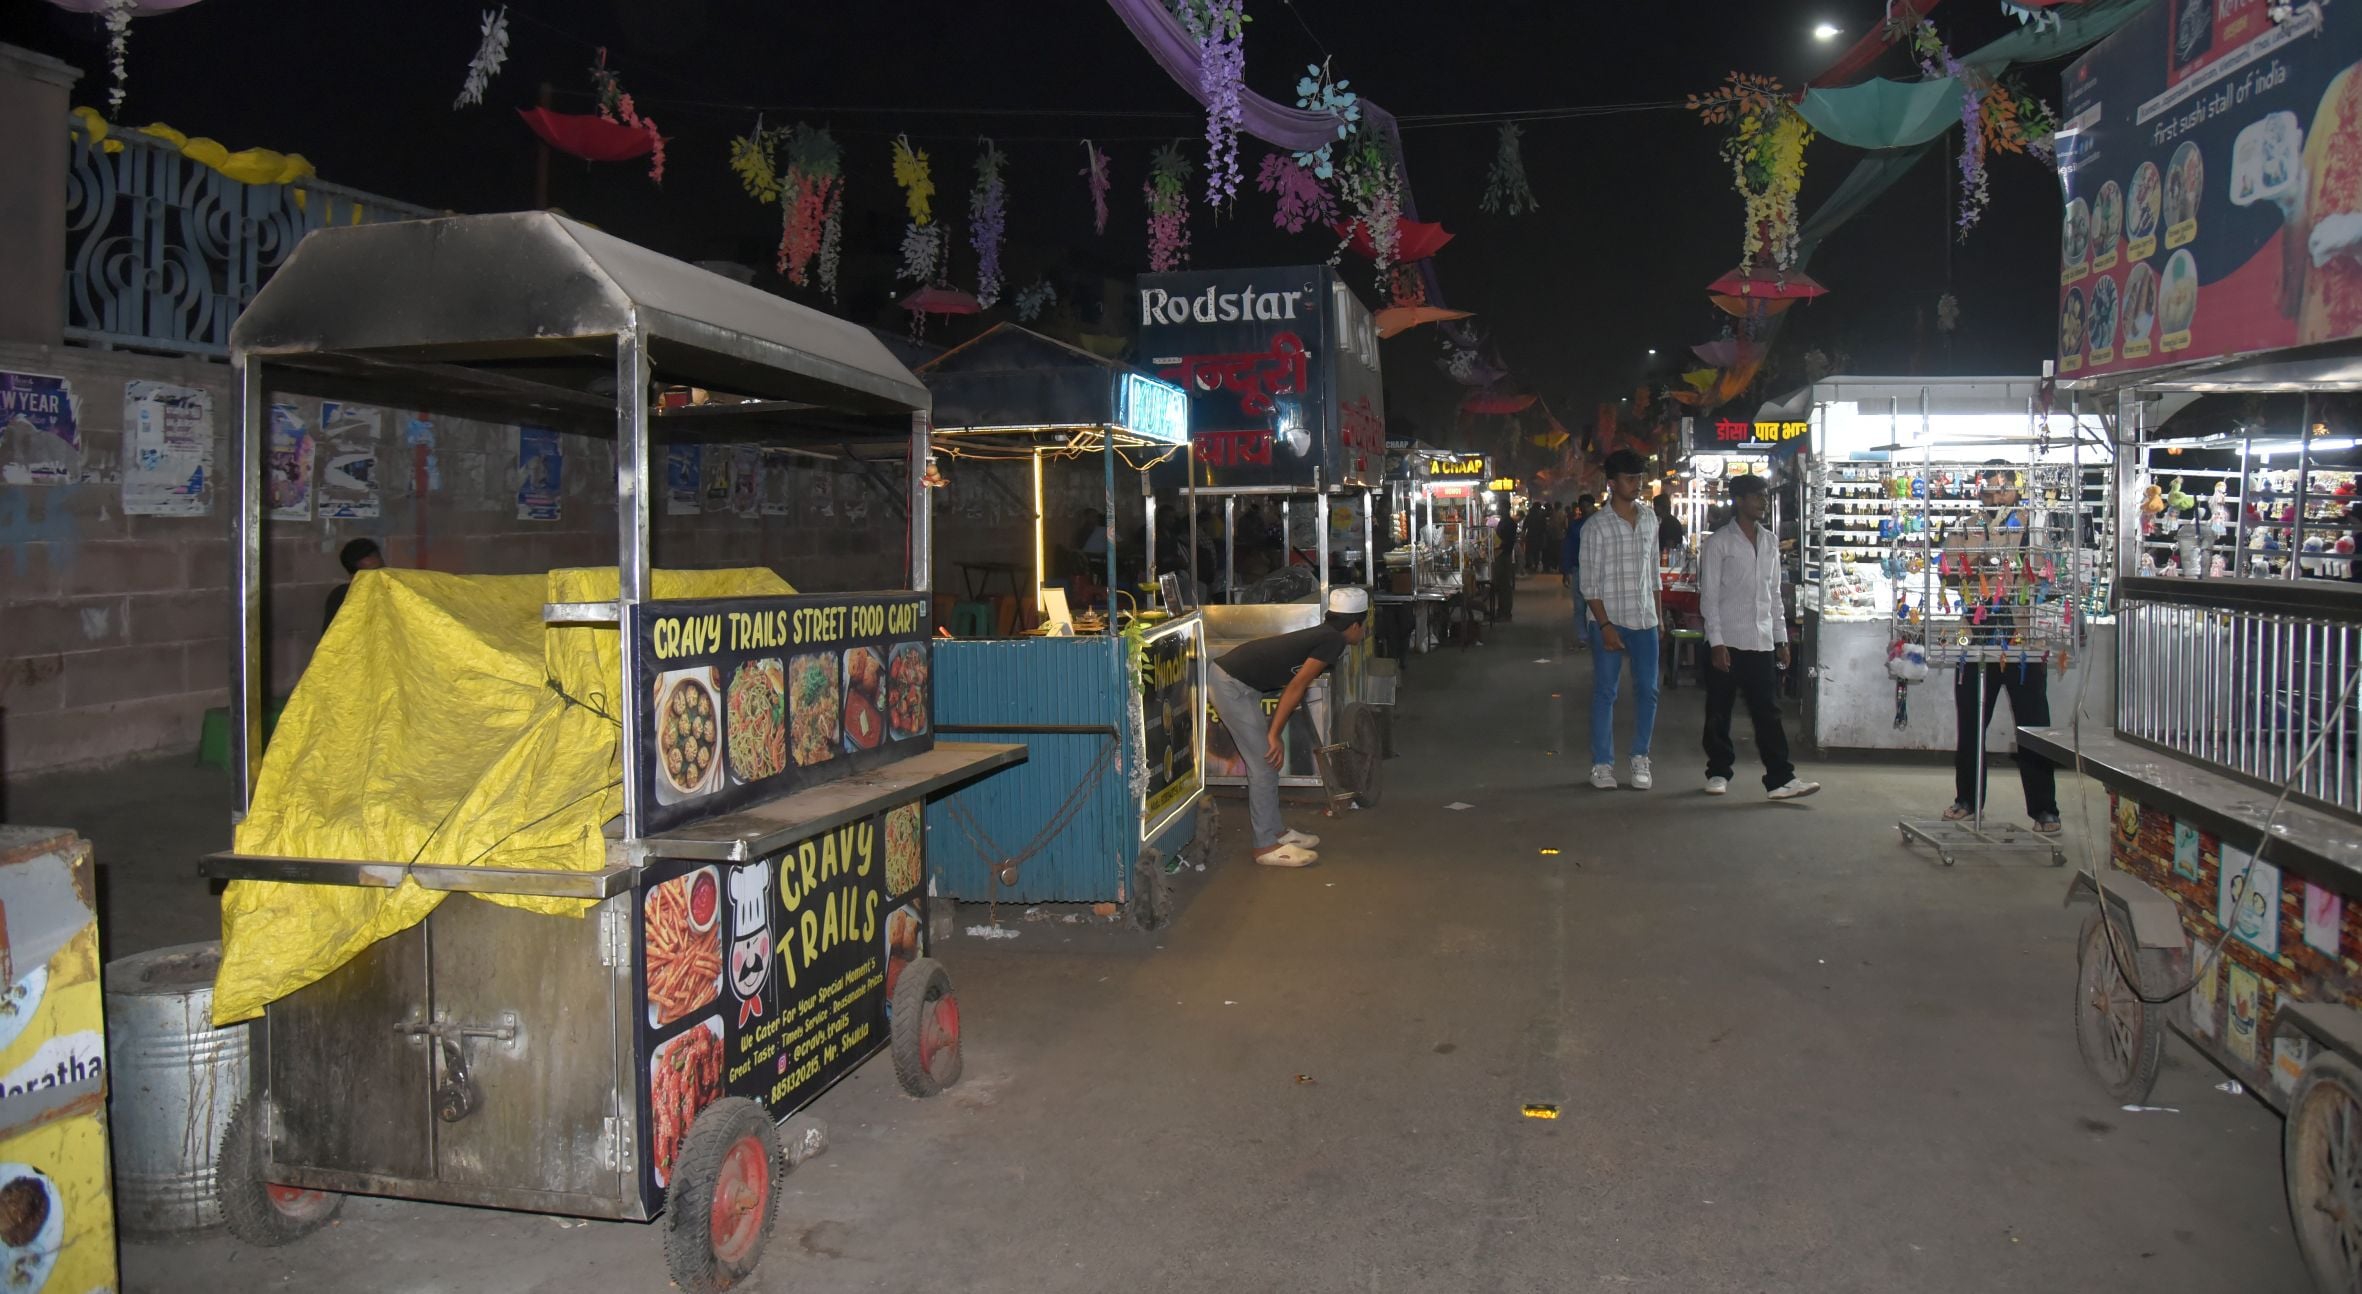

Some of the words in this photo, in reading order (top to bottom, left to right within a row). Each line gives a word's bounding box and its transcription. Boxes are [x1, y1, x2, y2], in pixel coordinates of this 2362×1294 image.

[2154, 117, 2177, 146] first
[2180, 98, 2206, 134] sushi
[2208, 82, 2234, 118] stall
[2236, 74, 2252, 104] of
[2255, 58, 2287, 95] india
[1140, 285, 1302, 326] Rodstar
[0, 390, 16, 409] W
[19, 392, 60, 413] YEAR
[1386, 440, 1409, 449] CHAAP
[1715, 417, 1749, 441] डोसा
[1754, 422, 1780, 441] पाव
[1442, 459, 1484, 474] CHAAP
[653, 614, 722, 660] CRAVY
[728, 609, 788, 651] TRAILS
[793, 606, 847, 644] STREET
[850, 604, 885, 639] FOOD
[888, 602, 920, 635] CART
[780, 821, 874, 913] CRAVY
[776, 885, 879, 989] TRAILS
[729, 1060, 752, 1084] Great
[754, 1044, 776, 1066] Taste
[782, 1028, 804, 1049] Timely
[805, 1010, 828, 1033] Service
[833, 985, 867, 1014] Reasonable
[867, 970, 885, 997] Prices
[740, 1034, 754, 1054] We
[756, 1018, 781, 1042] Cater
[782, 1008, 797, 1027] For
[798, 995, 817, 1017] Your
[818, 980, 844, 1004] Special
[845, 955, 877, 987] Moment's
[824, 1043, 839, 1066] Mr.
[841, 1022, 870, 1053] Shukla
